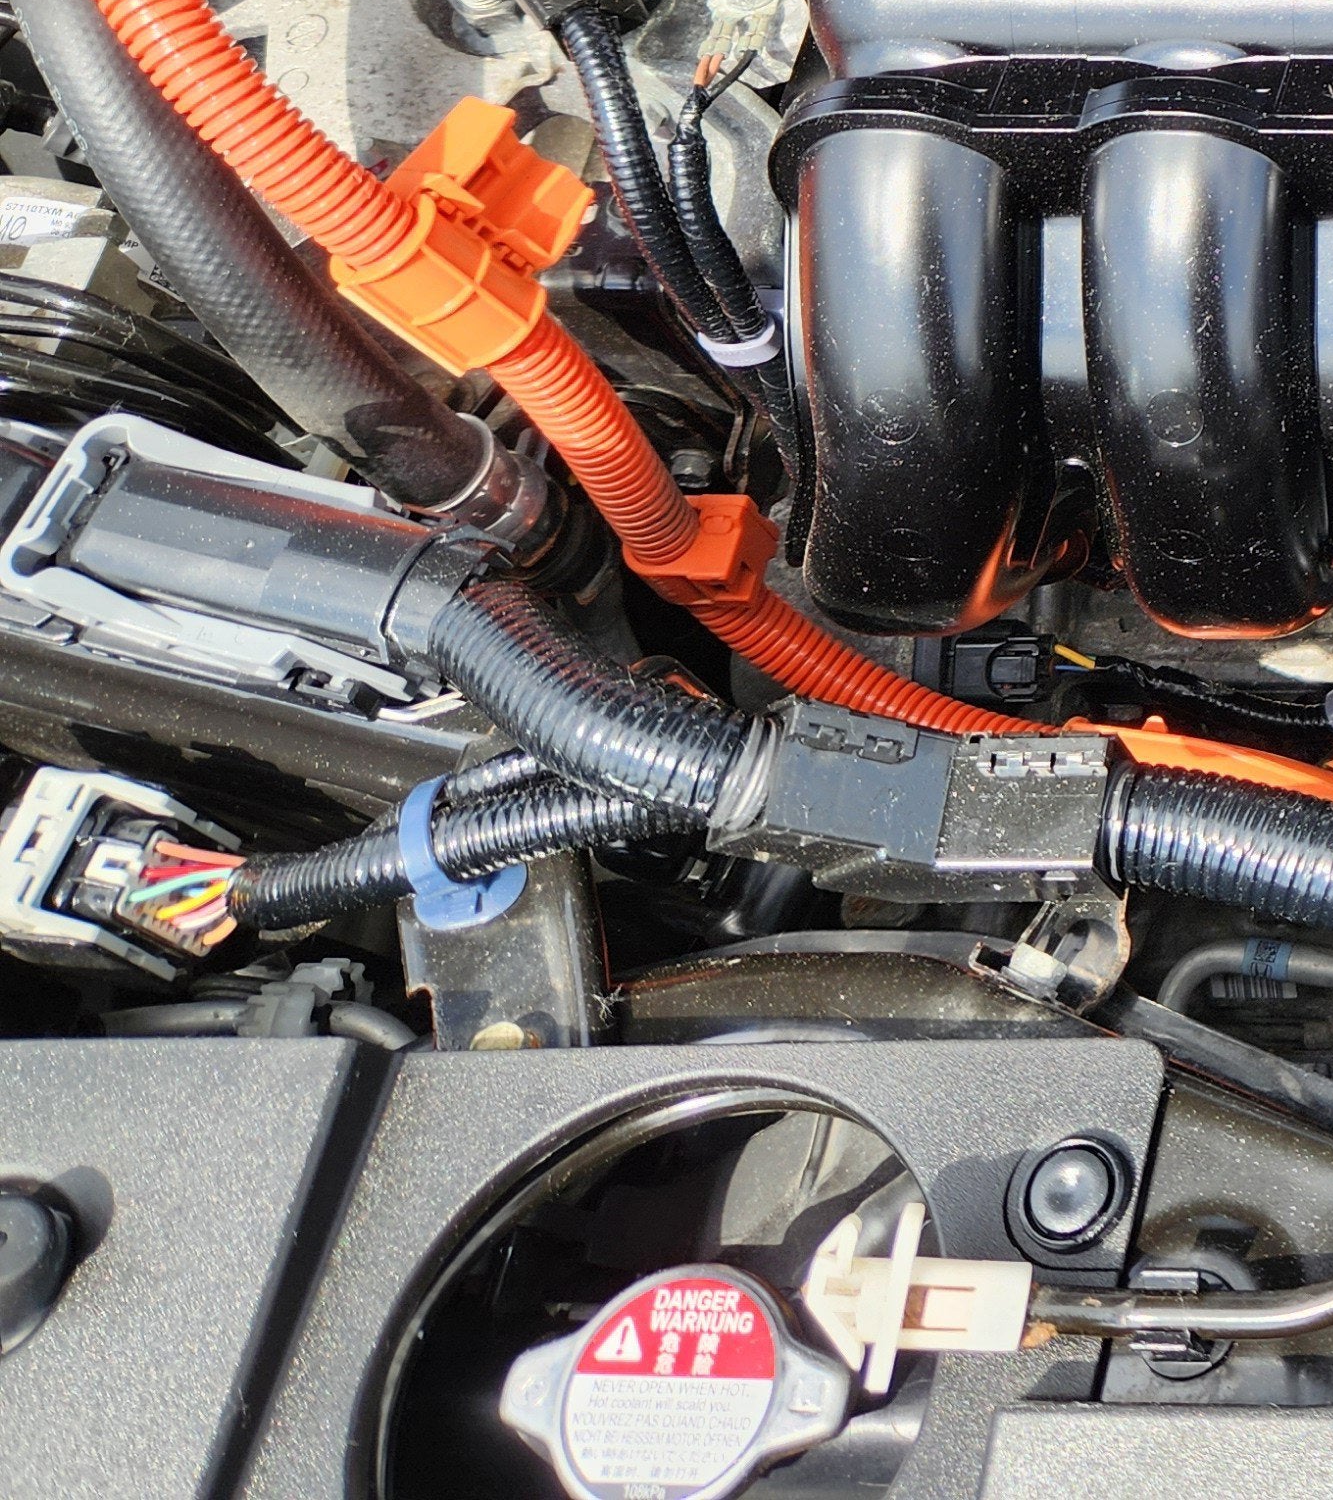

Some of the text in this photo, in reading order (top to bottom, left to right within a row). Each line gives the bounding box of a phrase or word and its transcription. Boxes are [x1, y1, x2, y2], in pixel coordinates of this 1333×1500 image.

[654, 1289, 741, 1311] DANGER
[650, 1309, 755, 1335] WARNUNG
[592, 1380, 638, 1393] NEVER
[639, 1381, 675, 1394] OPEN
[678, 1383, 717, 1396] WHEN
[588, 1397, 609, 1408] Hot
[611, 1398, 653, 1410] coolant
[655, 1399, 673, 1410] will
[675, 1399, 706, 1411] scald
[572, 1412, 751, 1430] N'OUVREZ PAS QUAND CHAUD
[666, 1432, 703, 1446] MOTOR
